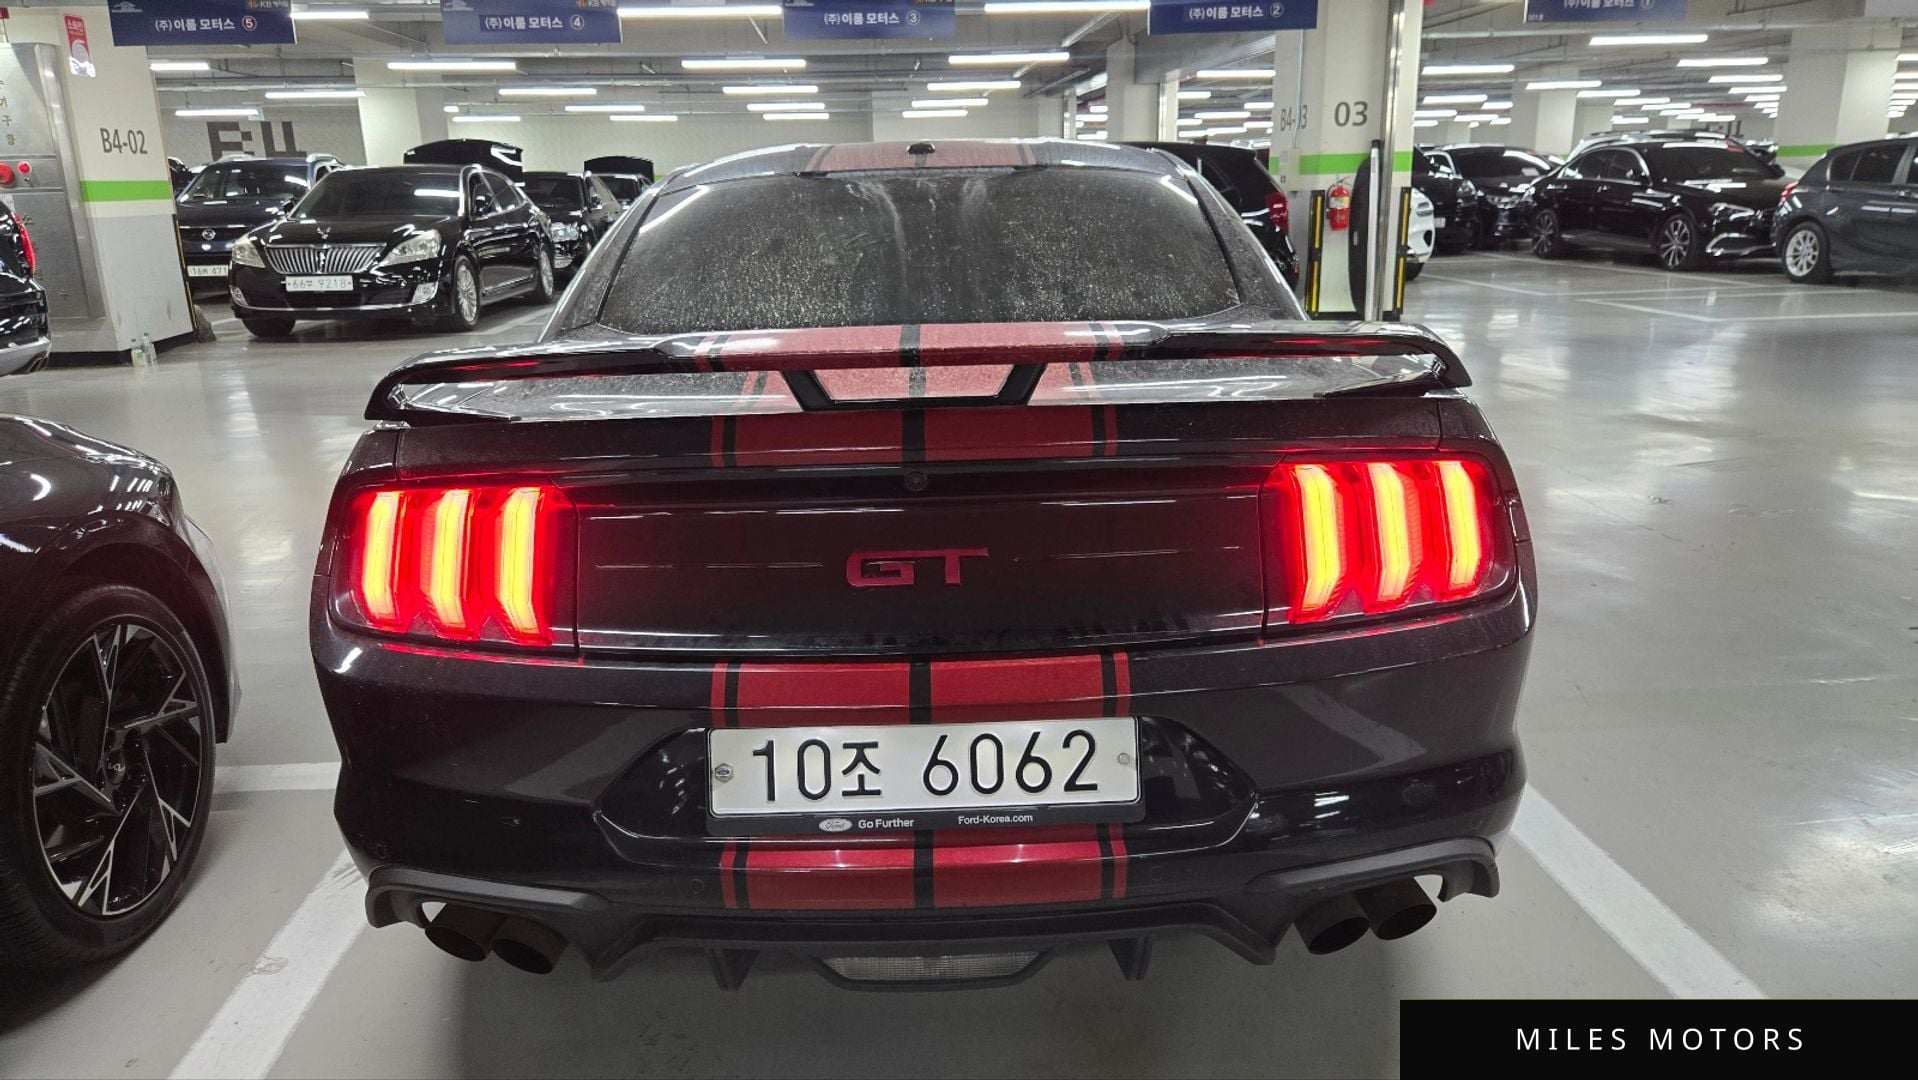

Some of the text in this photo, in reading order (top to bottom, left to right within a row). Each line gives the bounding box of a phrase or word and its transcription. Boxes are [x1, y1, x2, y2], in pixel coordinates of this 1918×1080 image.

[866, 12, 900, 25] 모터스
[1230, 6, 1264, 18] 모터스
[200, 17, 235, 31] 모터스
[528, 15, 563, 29] 모터스
[1334, 101, 1369, 127] 03
[100, 128, 148, 155] B4-02
[318, 279, 347, 289] 9218
[846, 547, 989, 587] GT
[752, 728, 1098, 802] 10조 6062
[858, 819, 874, 829] Go
[875, 818, 914, 829] Further
[958, 814, 1033, 825] Ford-Korea.com
